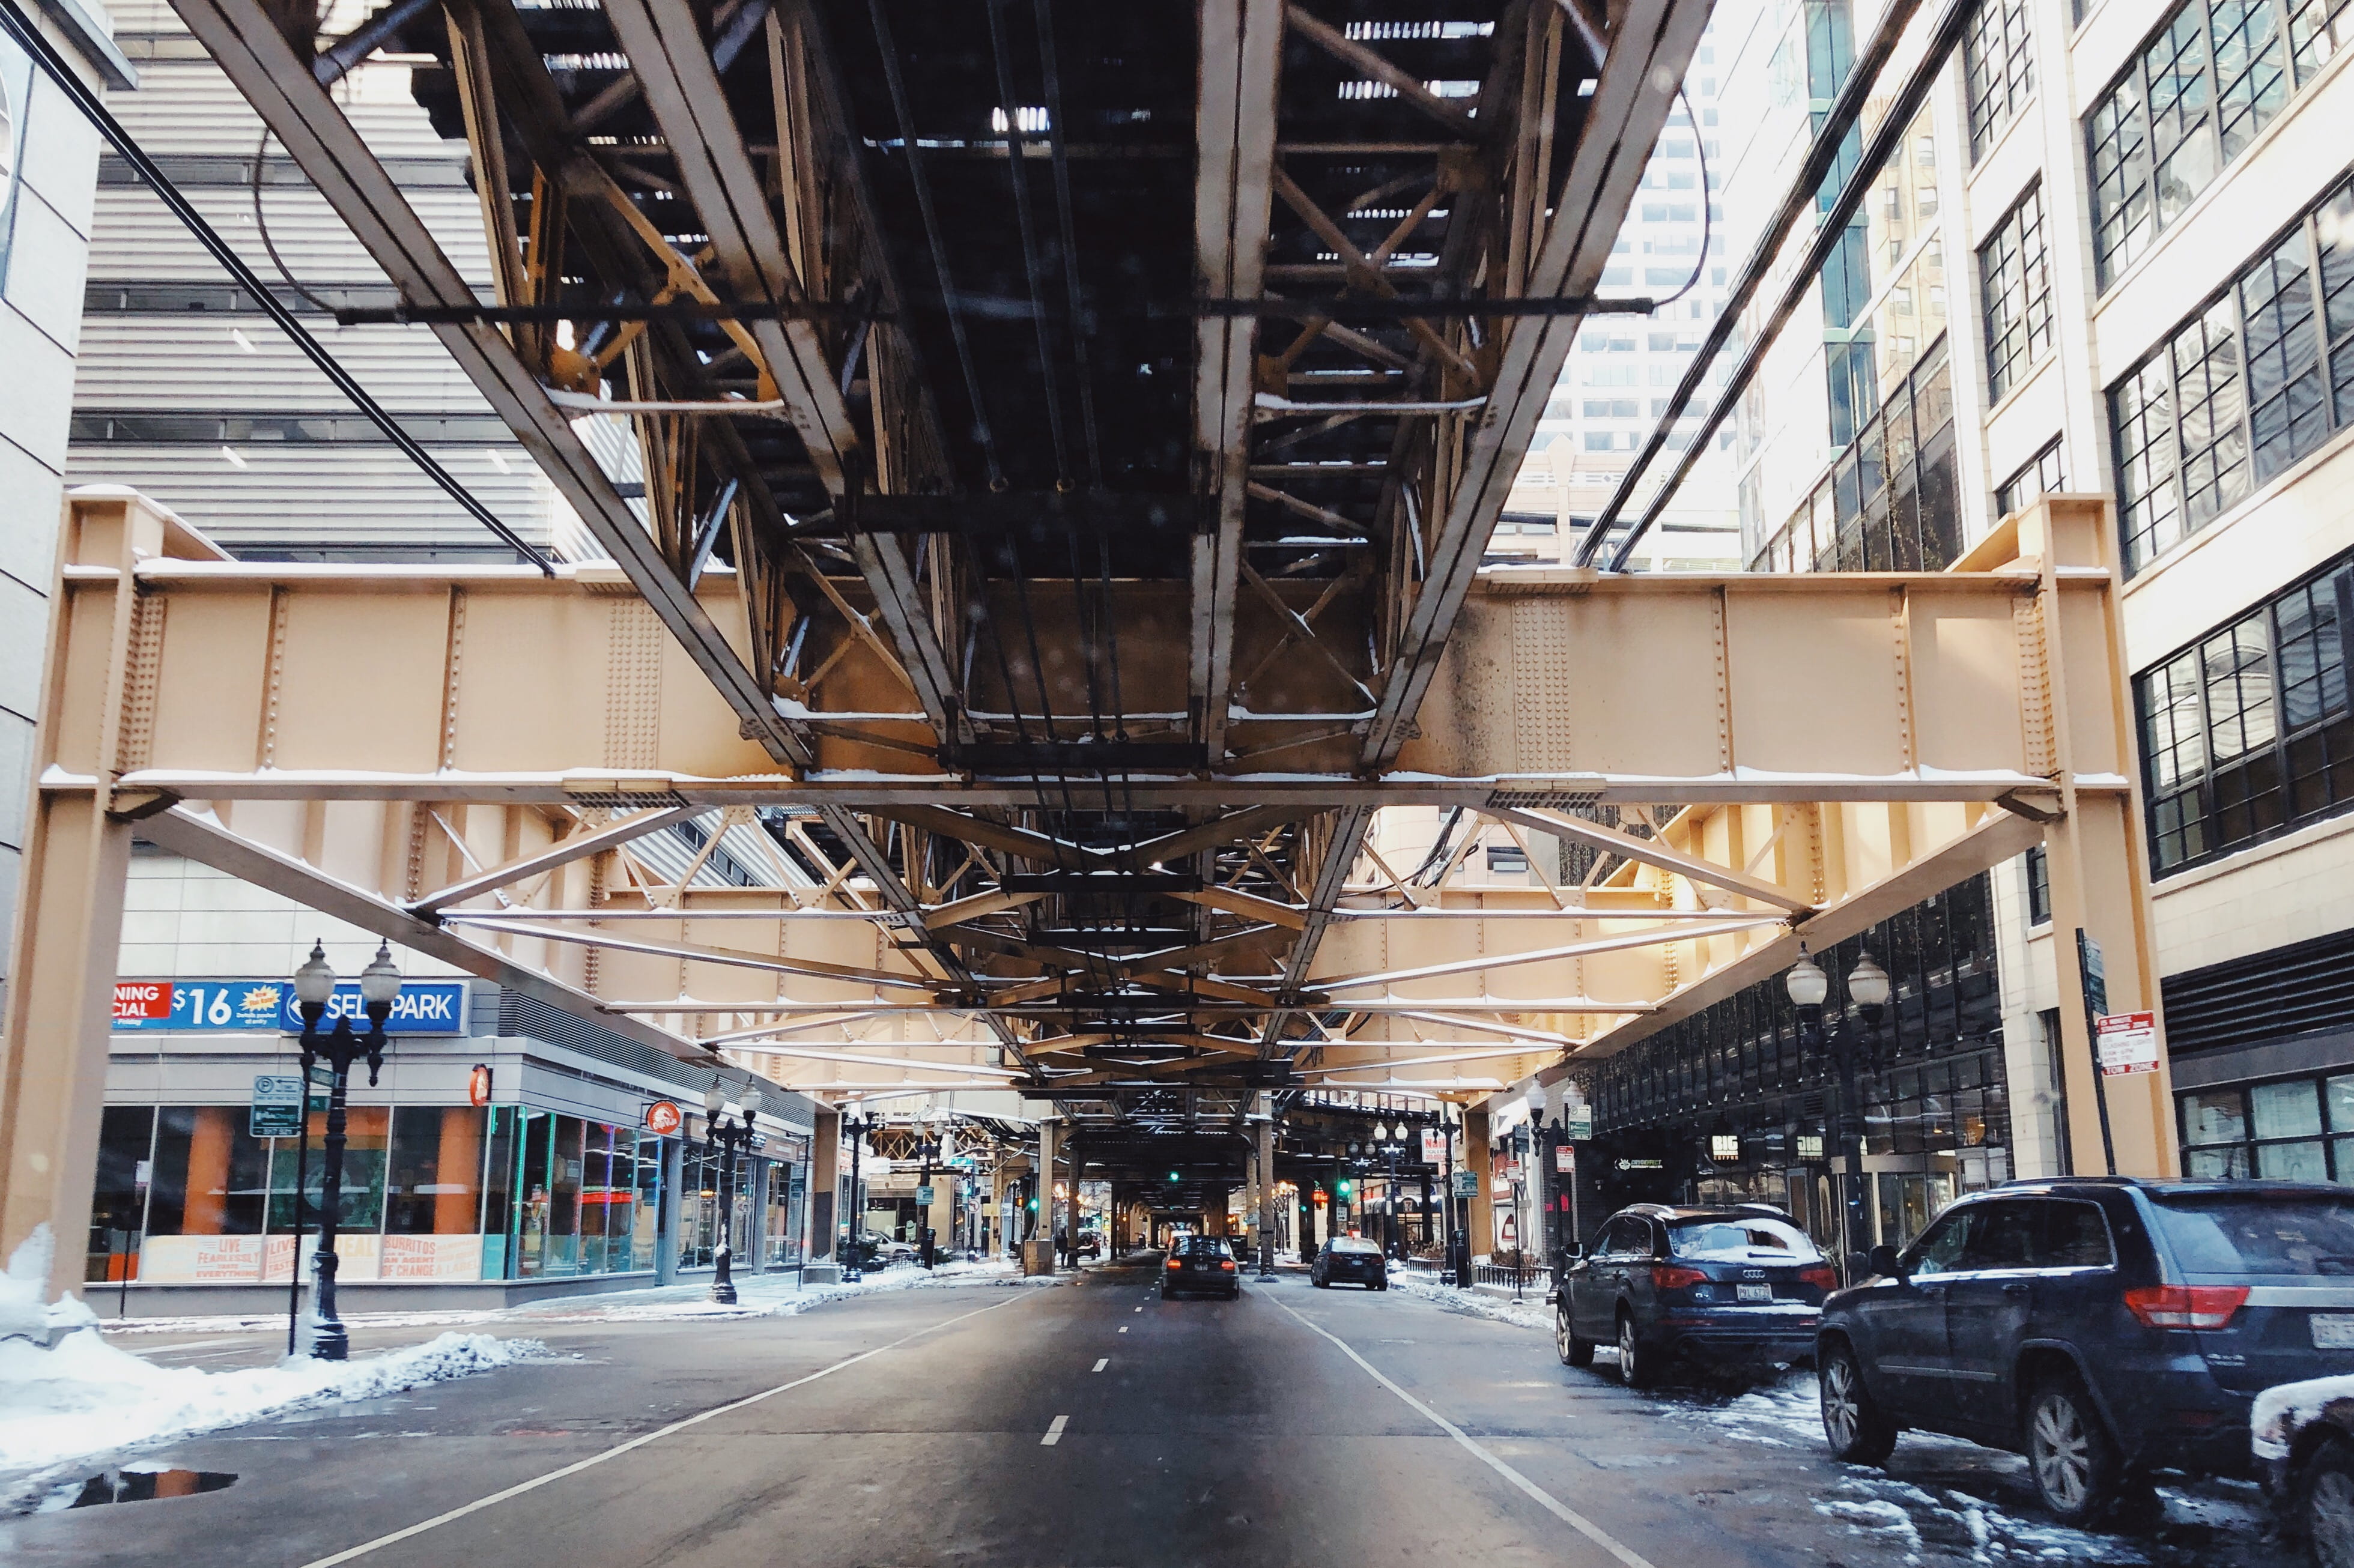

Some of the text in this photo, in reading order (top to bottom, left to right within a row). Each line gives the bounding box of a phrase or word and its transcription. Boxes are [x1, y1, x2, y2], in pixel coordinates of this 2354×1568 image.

[172, 988, 232, 1025] $16
[326, 993, 453, 1020] SEL PARK
[2106, 1062, 2155, 1074] TOW ZONE
[1425, 1138, 1446, 1148] Nail
[1712, 1135, 1738, 1151] BIG
[218, 1238, 241, 1253] LIVE
[383, 1235, 435, 1255] BURRITOS
[396, 1265, 434, 1277] CHANGE
